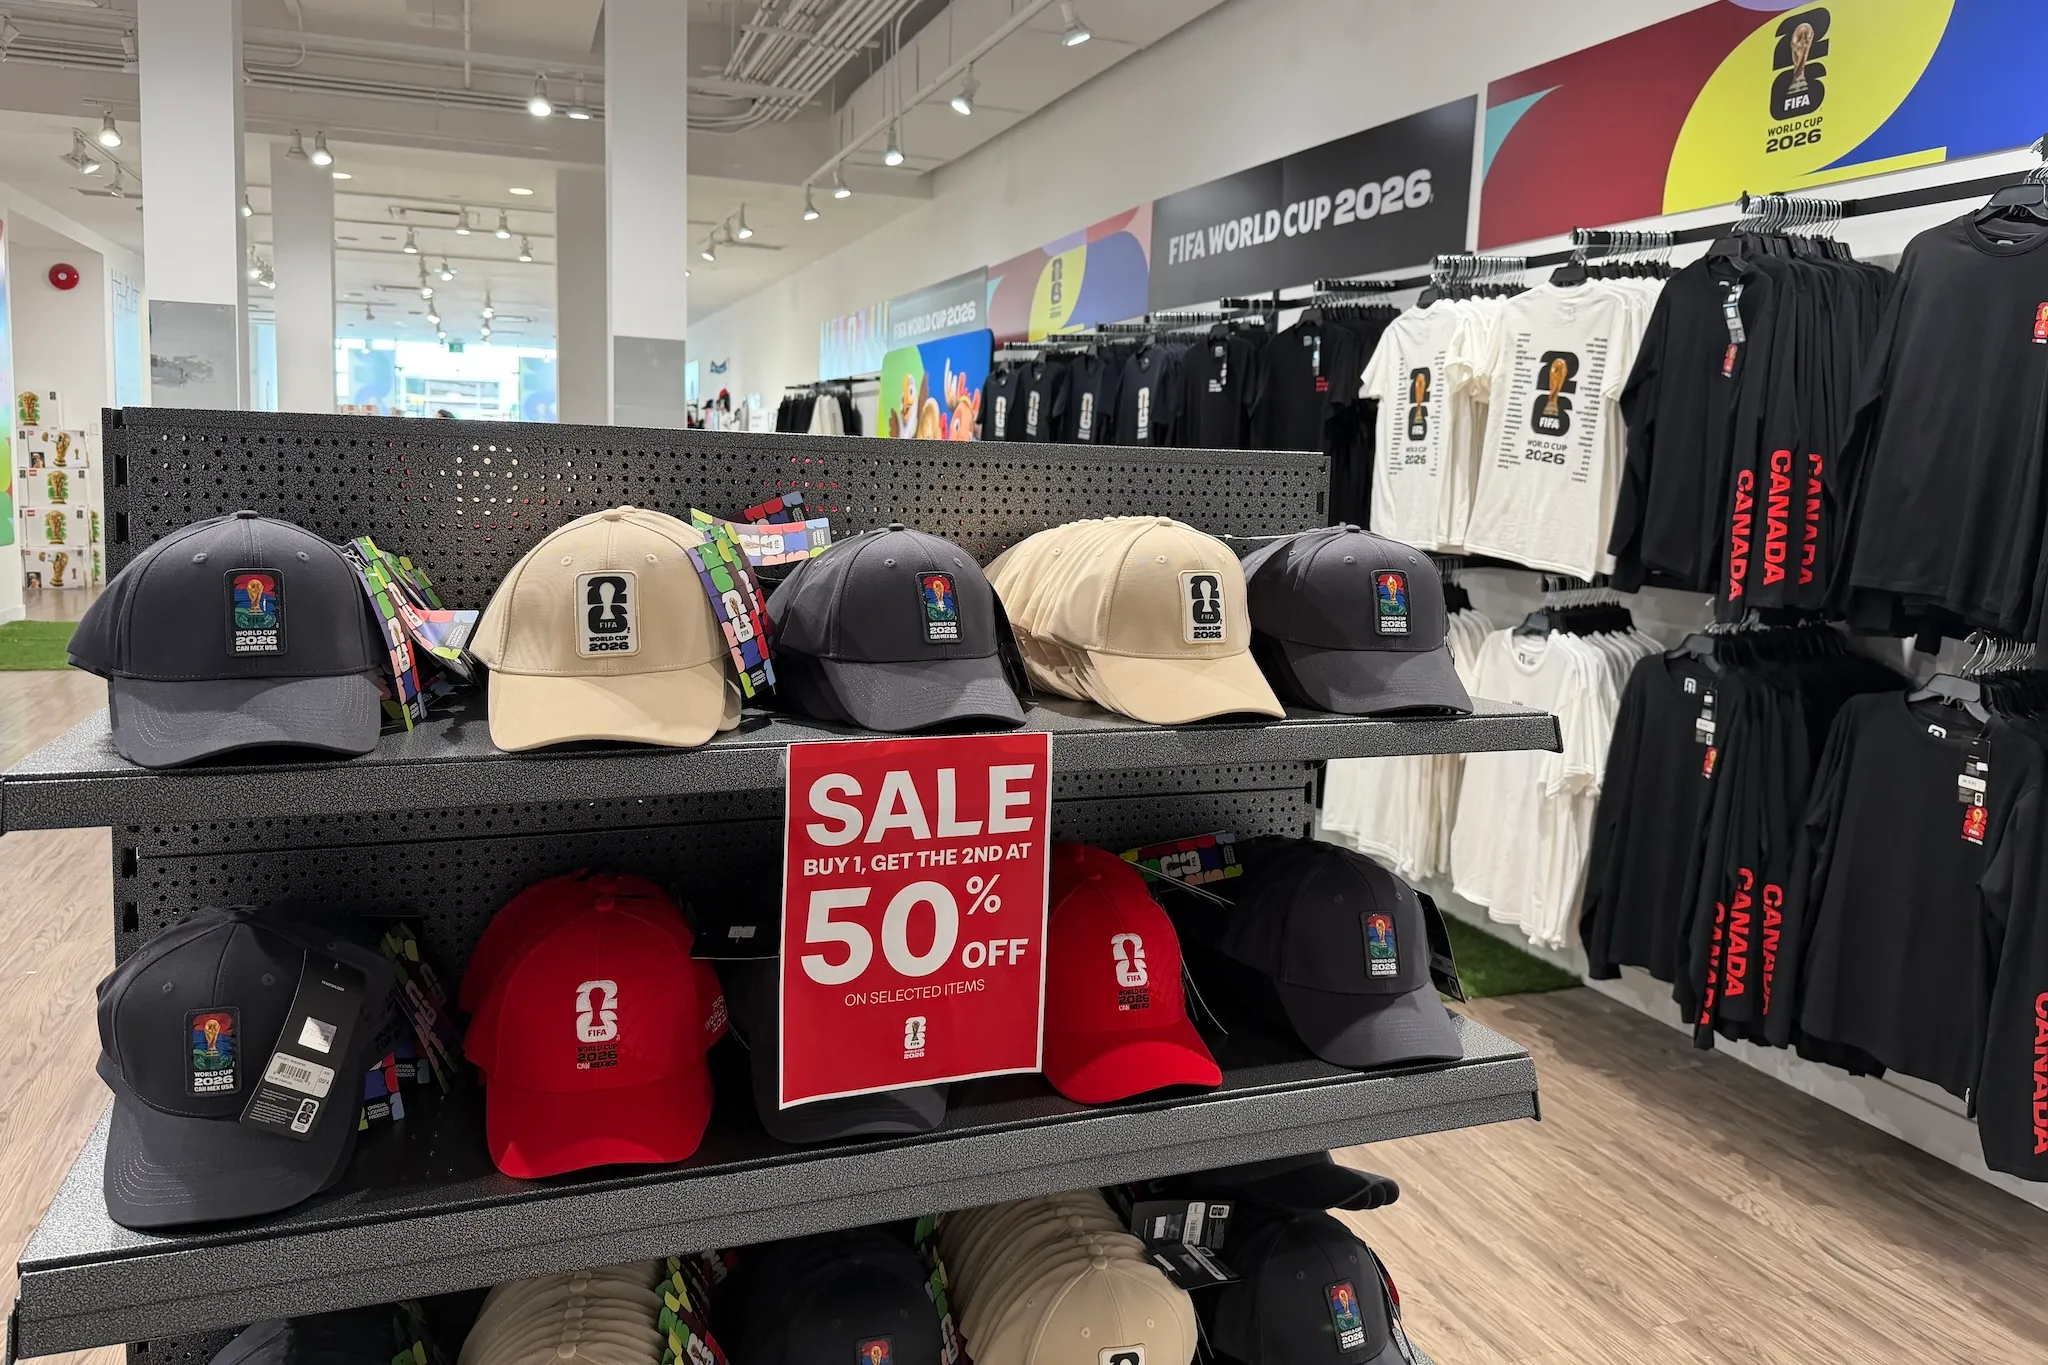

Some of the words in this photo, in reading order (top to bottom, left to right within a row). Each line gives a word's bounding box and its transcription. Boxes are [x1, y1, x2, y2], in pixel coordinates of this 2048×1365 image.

[1784, 94, 1810, 111] FIFA
[1768, 122, 1801, 136] WORLD
[1804, 116, 1823, 128] CUP
[1766, 128, 1822, 154] 2026
[1168, 230, 1205, 265] FIFA
[1208, 209, 1280, 256] WORLD
[1283, 195, 1331, 238] CUP
[1333, 168, 1432, 226] 2026
[908, 315, 932, 337] WORLD
[932, 308, 946, 331] CUP
[946, 300, 976, 327] 2026
[1538, 416, 1560, 430] FIFA
[1527, 440, 1550, 449] WORLD
[1551, 442, 1568, 451] CUP
[1404, 454, 1426, 465] 2026
[1525, 449, 1566, 465] 2026
[1763, 450, 1792, 586] CANADA
[1728, 469, 1754, 602] CANADA
[236, 636, 277, 645] 2026
[589, 642, 629, 651] 2026
[806, 764, 1035, 846] SALE
[804, 858, 850, 876] BUY
[853, 856, 866, 875] 1,
[871, 852, 914, 872] GET
[916, 849, 958, 867] THE
[962, 844, 1003, 864] 2ND
[1005, 842, 1032, 859] AT
[1725, 868, 1753, 996] CANADA
[962, 938, 1029, 969] OFF
[845, 993, 866, 1007] ON
[870, 986, 941, 1005] SELECTED
[944, 978, 985, 996] ITEMS
[1119, 994, 1149, 1004] 2026
[577, 1050, 618, 1062] 2026
[194, 1075, 234, 1086] 2026
[1342, 1332, 1364, 1344] 2026
